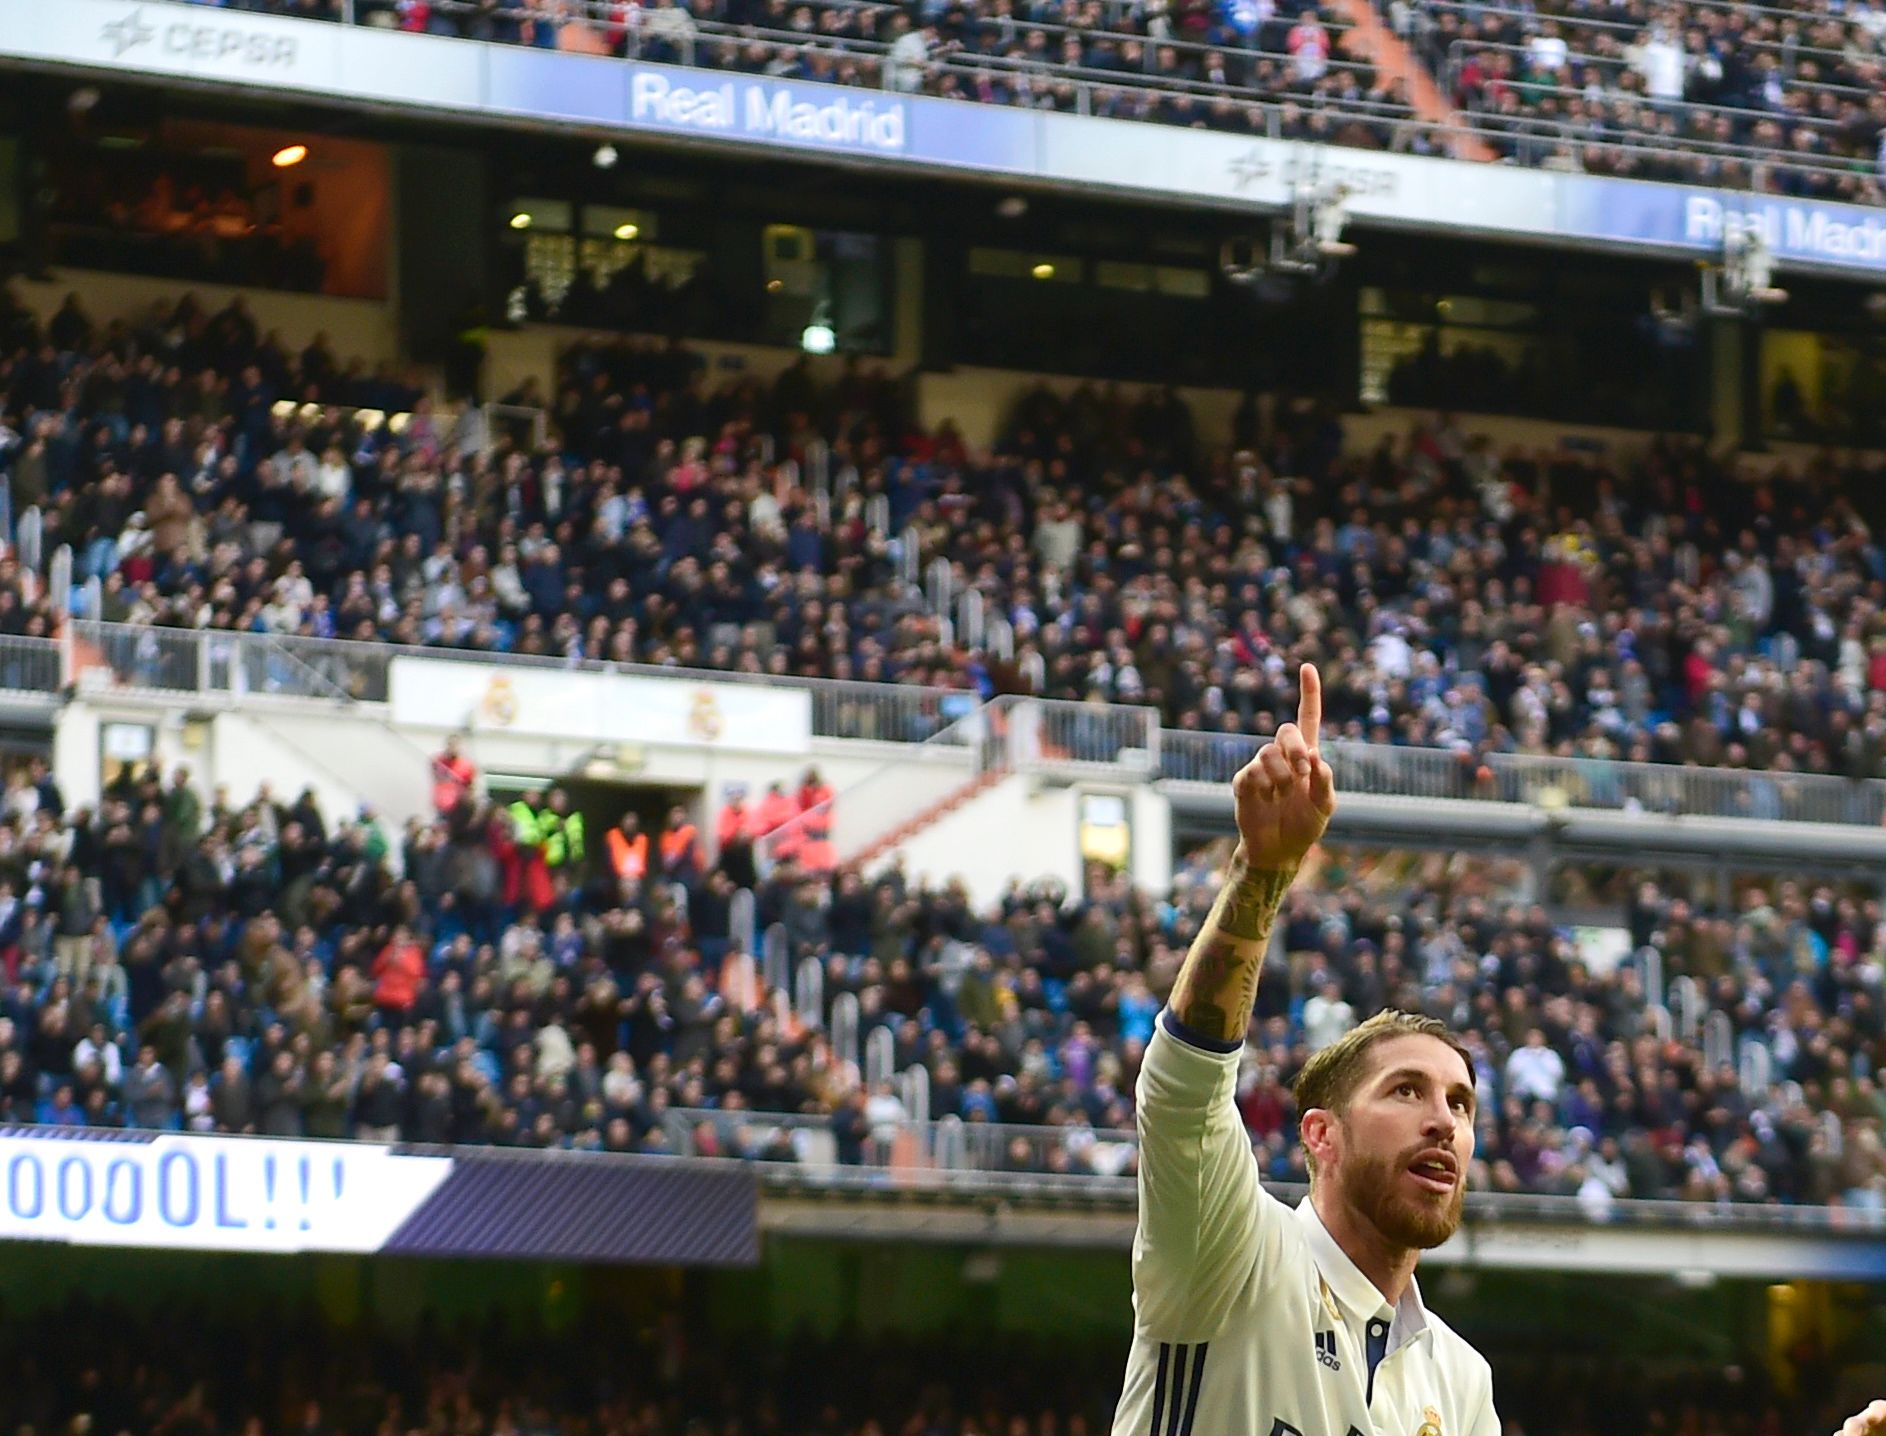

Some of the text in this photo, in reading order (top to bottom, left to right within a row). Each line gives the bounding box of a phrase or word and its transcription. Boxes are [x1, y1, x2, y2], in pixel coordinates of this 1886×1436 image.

[164, 23, 300, 68] CEPSA
[631, 72, 905, 148] Real Madrid
